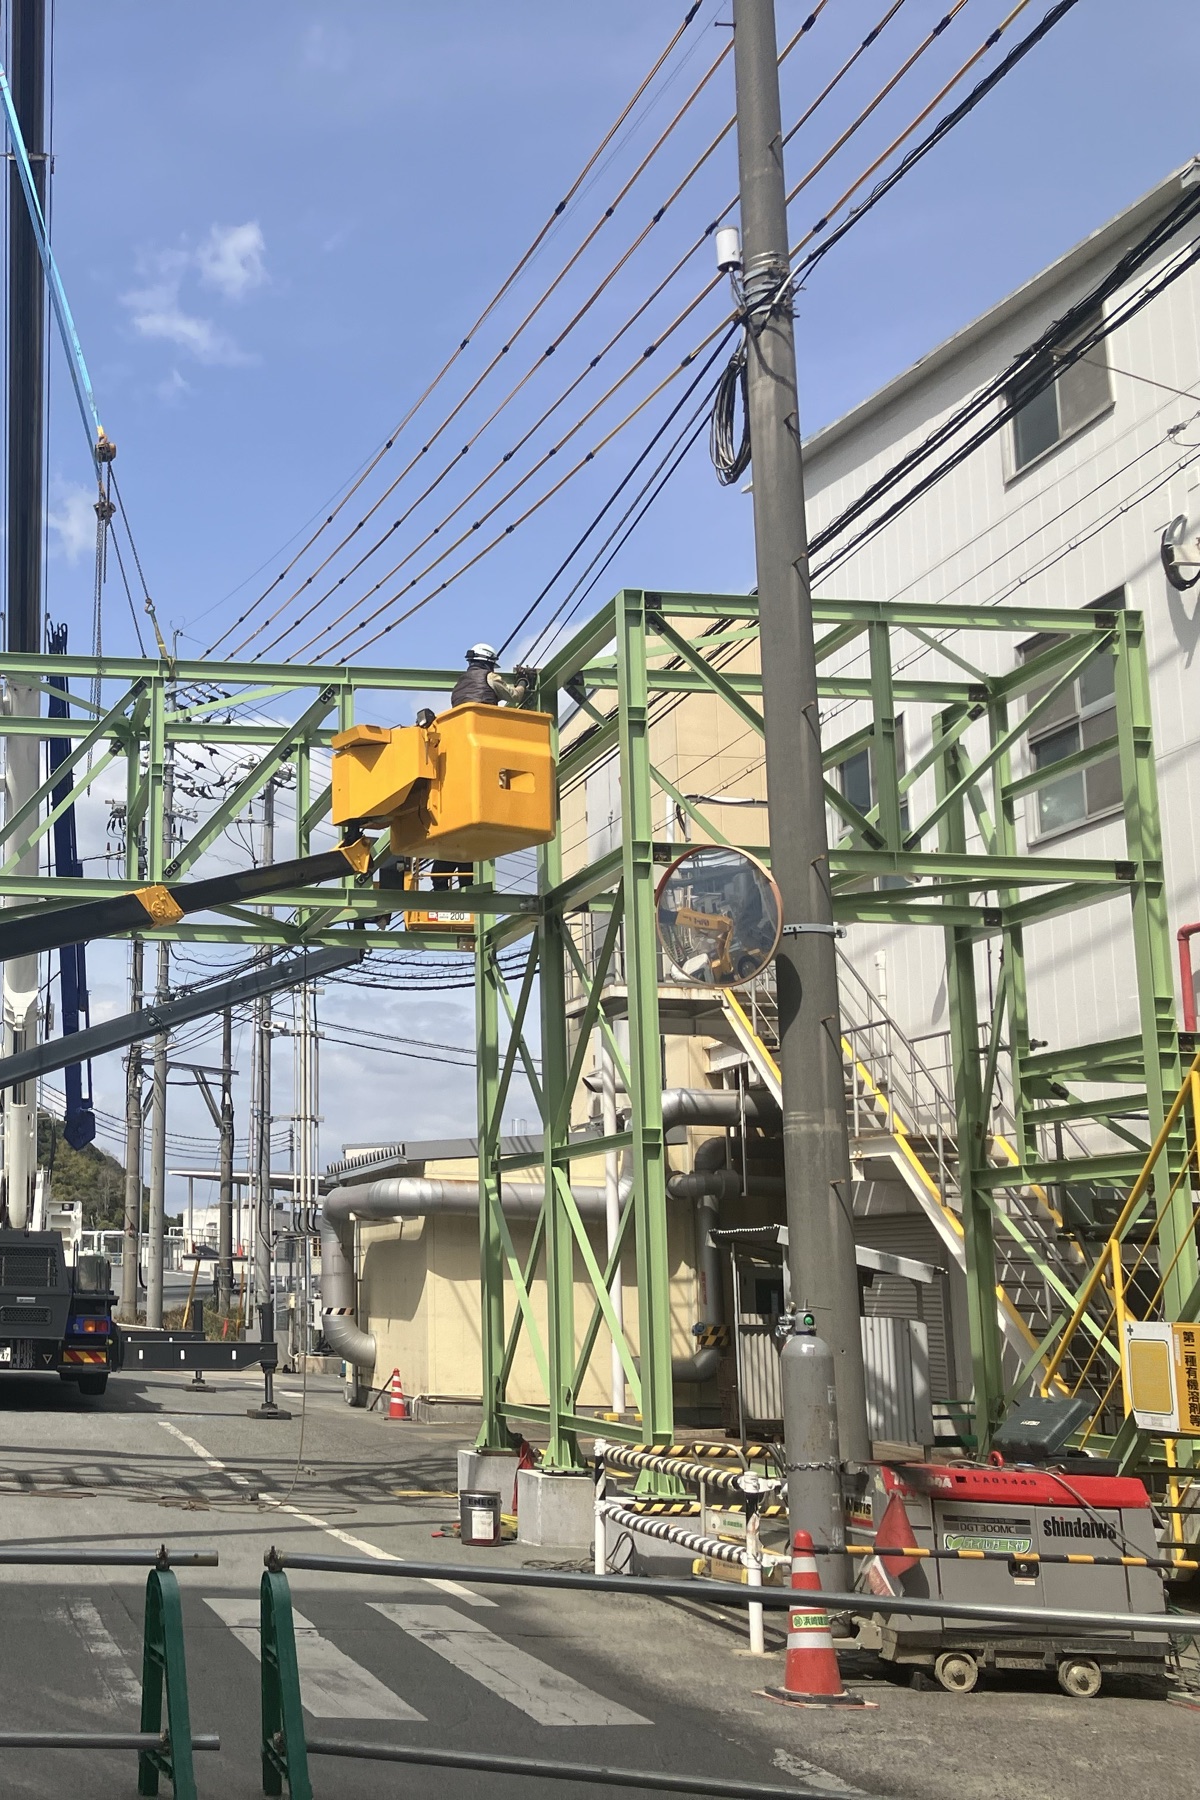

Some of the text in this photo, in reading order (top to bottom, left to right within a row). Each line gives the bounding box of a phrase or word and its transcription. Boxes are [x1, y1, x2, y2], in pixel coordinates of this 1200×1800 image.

[468, 1498, 498, 1506] ENEOS
[960, 1523, 1016, 1534] DGT300MC
[1043, 1515, 1118, 1540] shindaiwa
